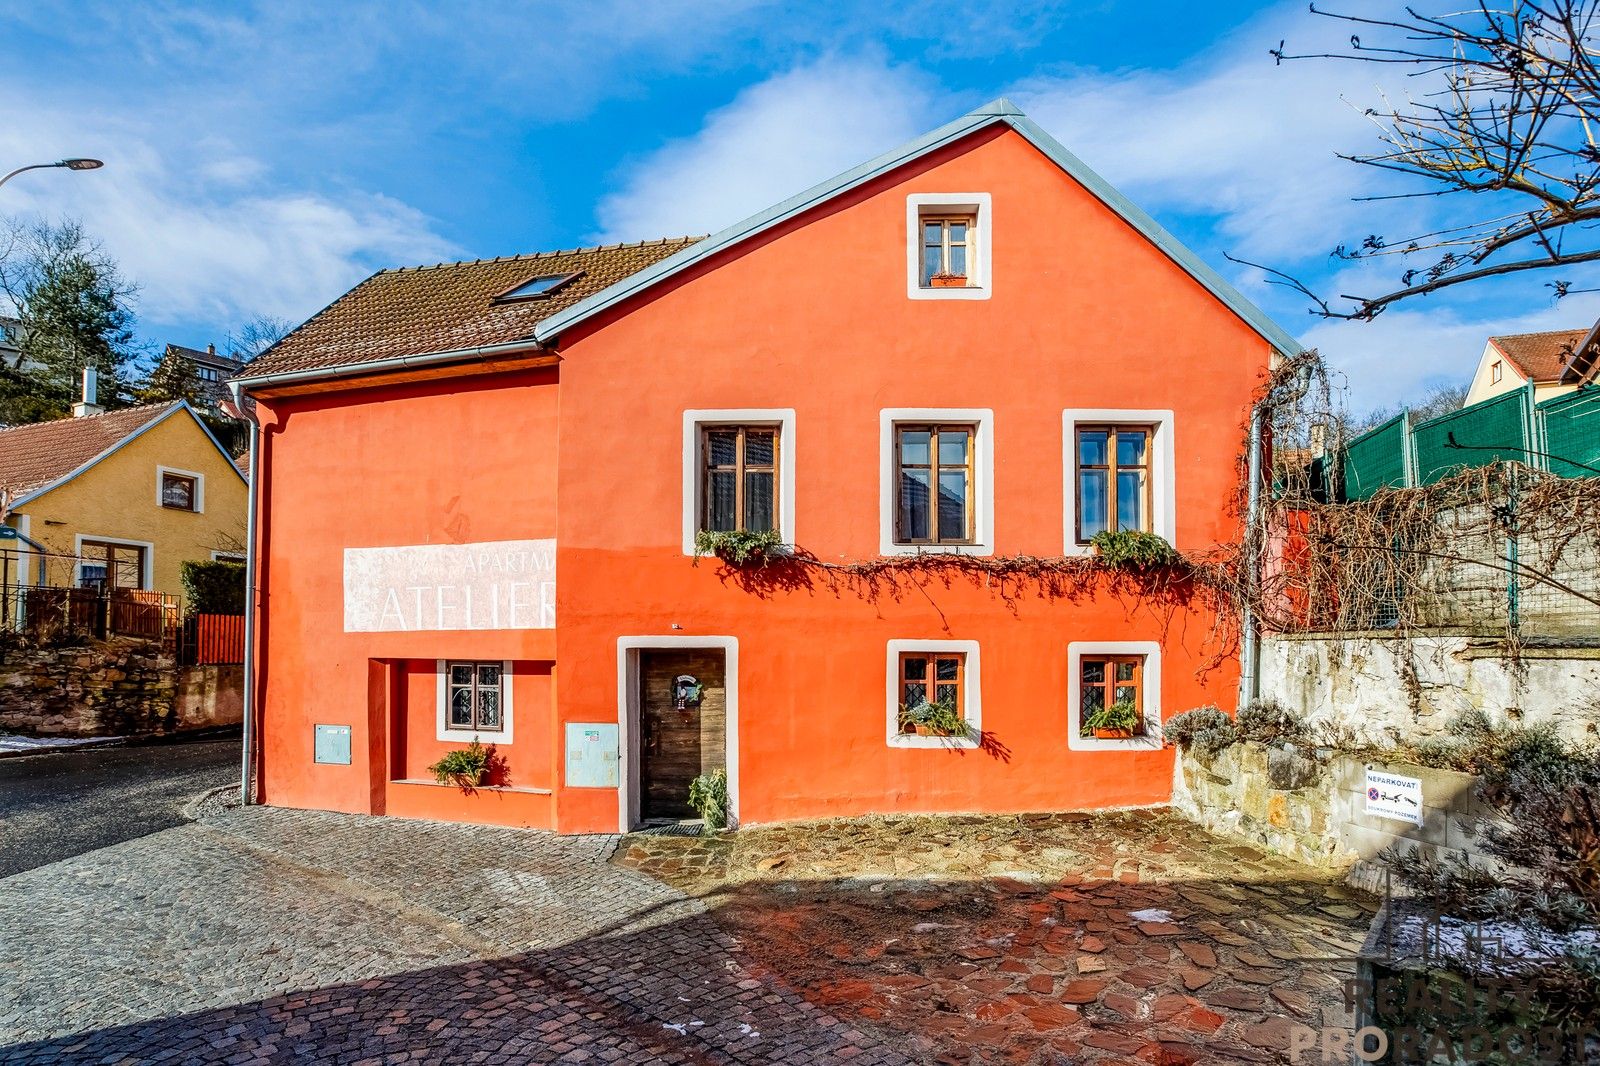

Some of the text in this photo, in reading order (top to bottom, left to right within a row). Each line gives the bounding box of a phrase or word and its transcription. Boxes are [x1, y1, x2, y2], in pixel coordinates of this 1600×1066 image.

[463, 551, 556, 575] APARTM
[1368, 775, 1416, 789] NEPARKOVAT
[1394, 811, 1418, 820] POZEMEK
